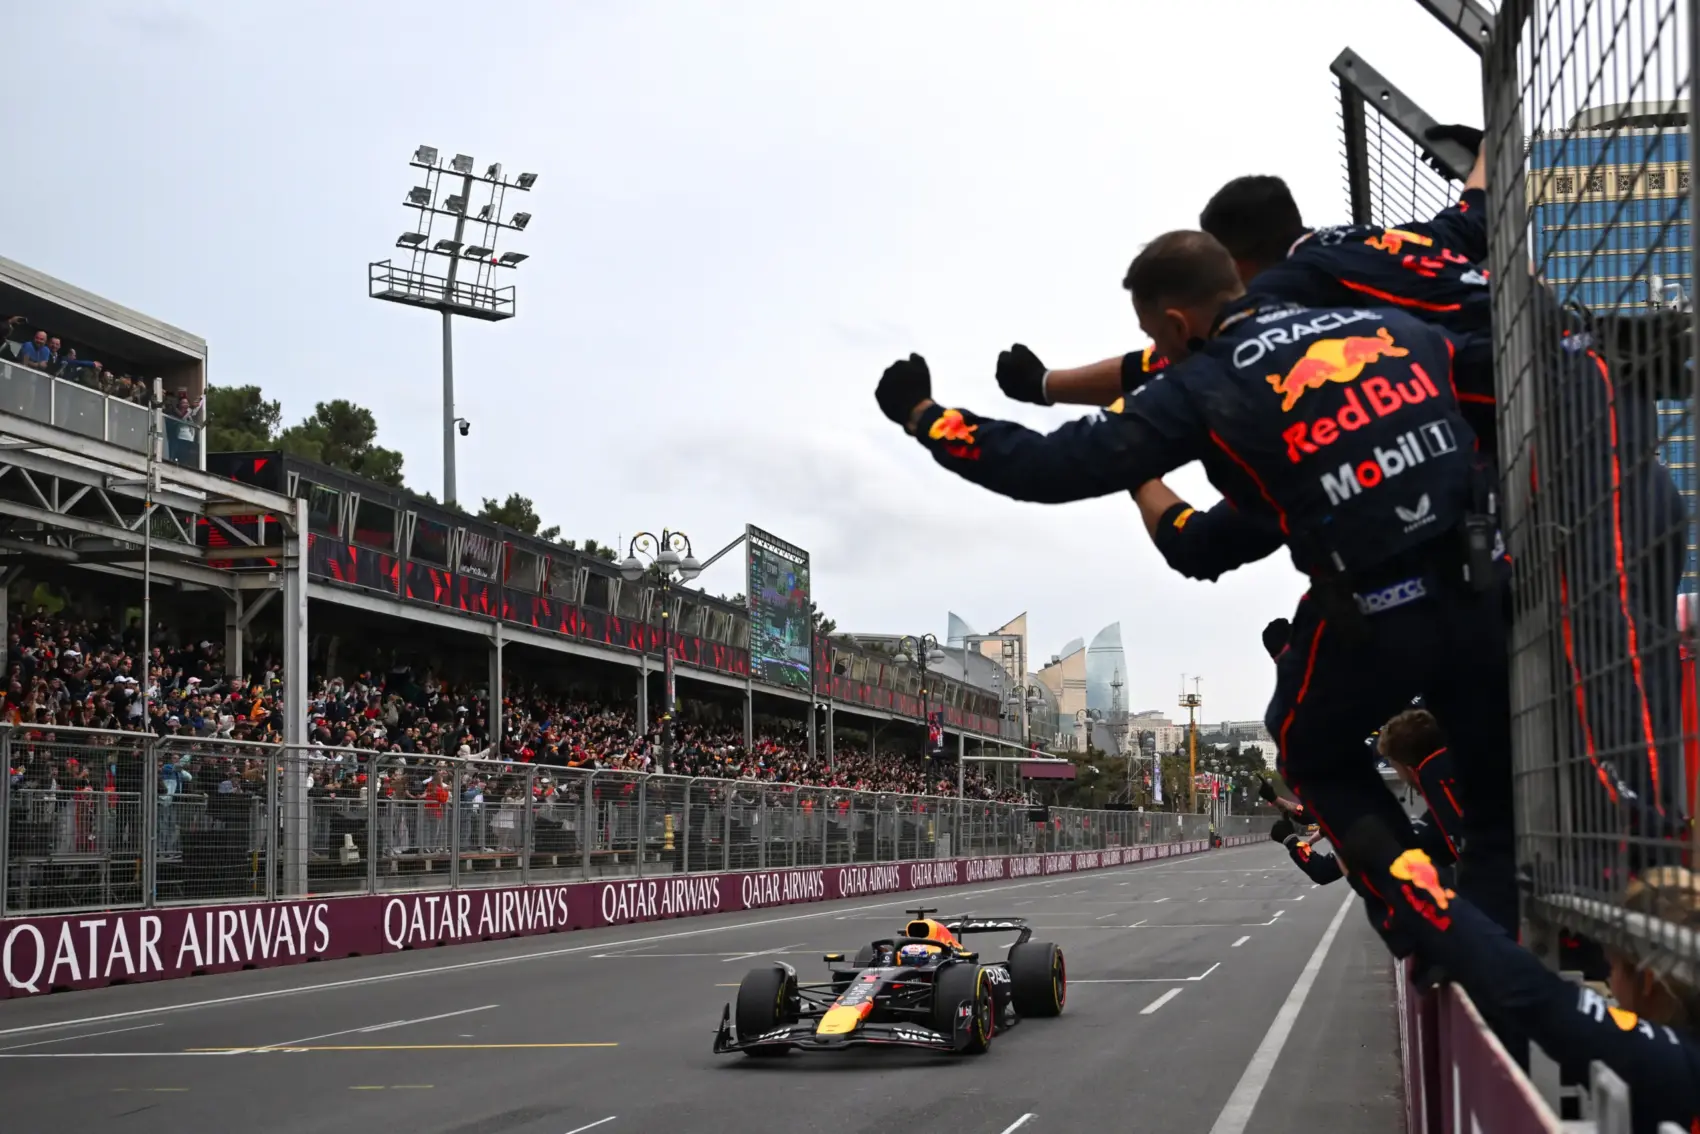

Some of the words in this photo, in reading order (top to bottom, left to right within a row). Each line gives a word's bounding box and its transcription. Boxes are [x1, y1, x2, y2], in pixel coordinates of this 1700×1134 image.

[1281, 386, 1372, 464] Red
[1319, 430, 1427, 507] Mobil
[601, 881, 657, 923] QATAR
[660, 877, 720, 914] AIRWAYS
[742, 872, 780, 909] QATAR
[782, 869, 824, 901] AIRWAYS
[839, 867, 867, 897] QATAR
[869, 865, 900, 891] AIRWAYS
[3, 915, 164, 993] QATAR
[176, 903, 330, 968] AIRWAYS
[384, 893, 472, 950] QATAR
[478, 887, 568, 935] AIRWAYS
